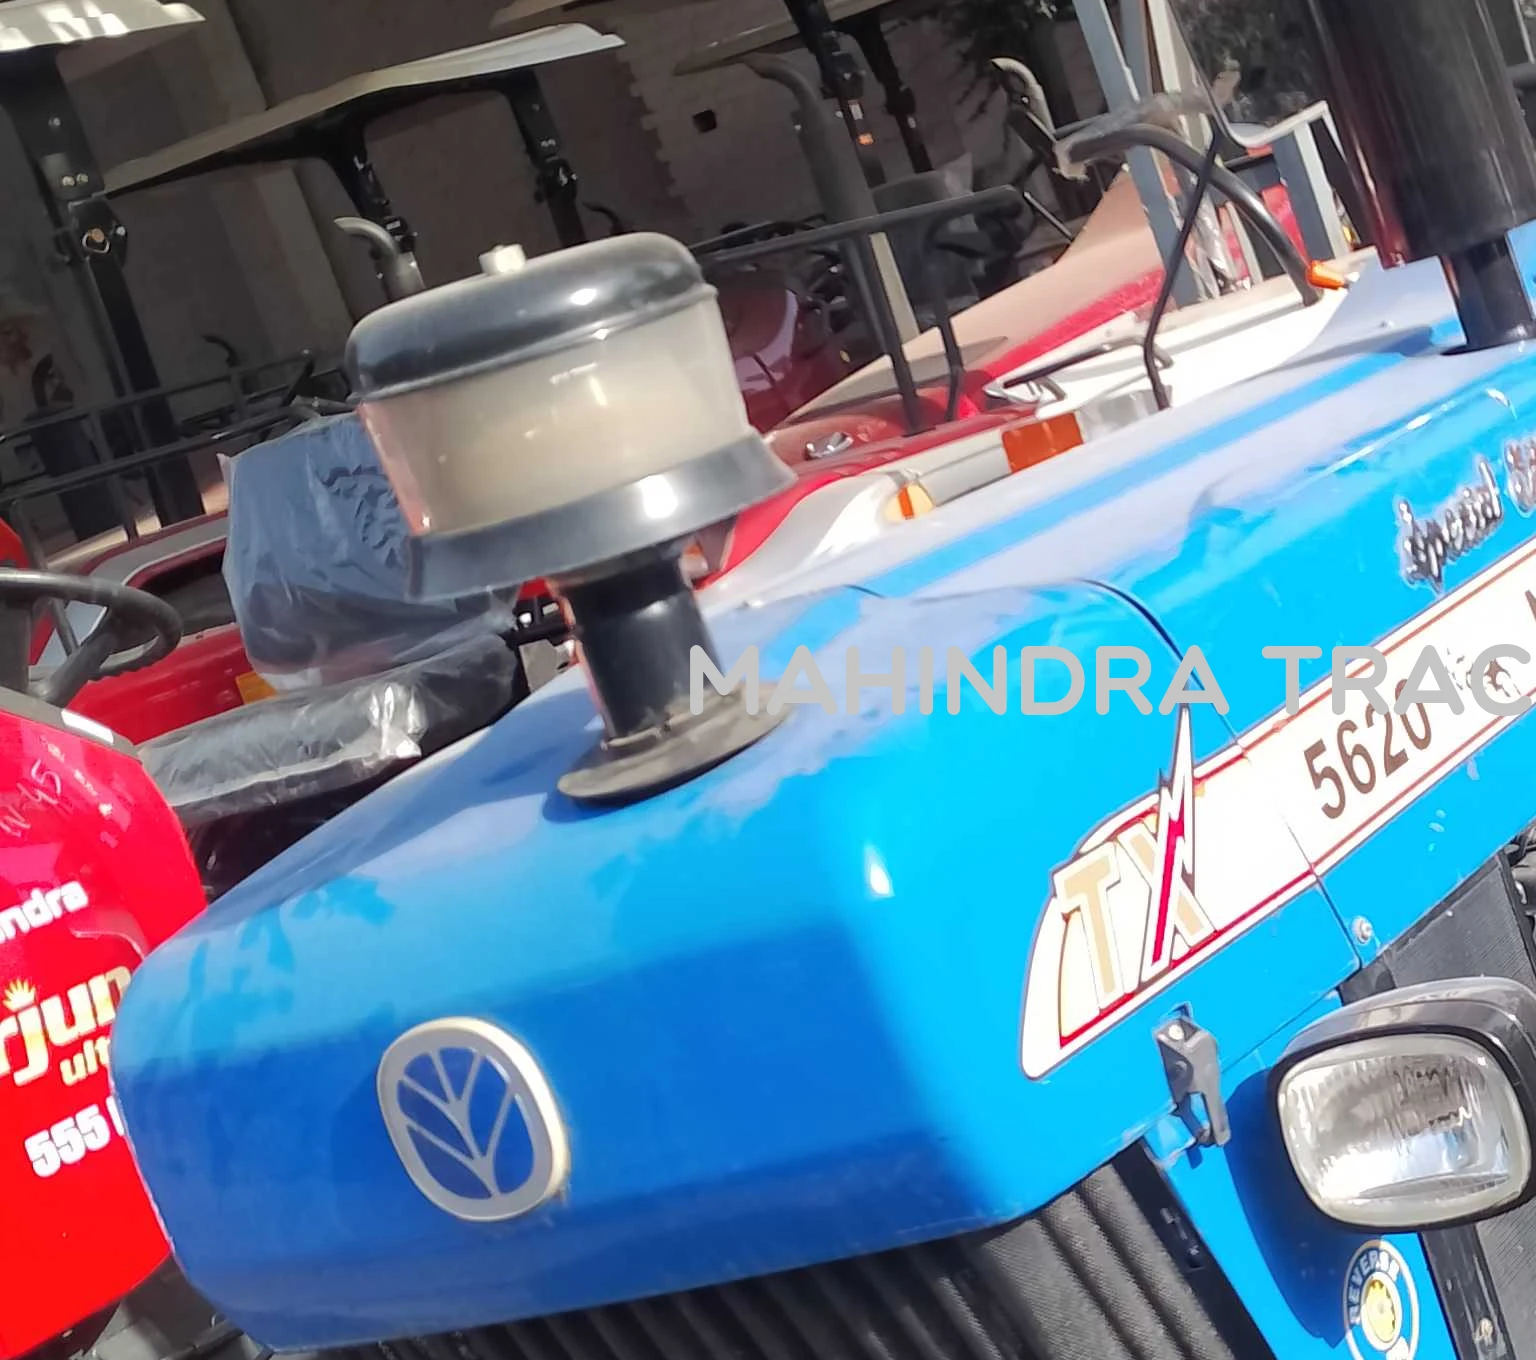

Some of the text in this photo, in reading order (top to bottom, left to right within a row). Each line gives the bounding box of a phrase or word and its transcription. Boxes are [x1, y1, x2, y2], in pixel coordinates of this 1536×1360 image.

[1052, 710, 1217, 1010] TX
[1304, 678, 1432, 820] 5620
[25, 1103, 111, 1178] 555
